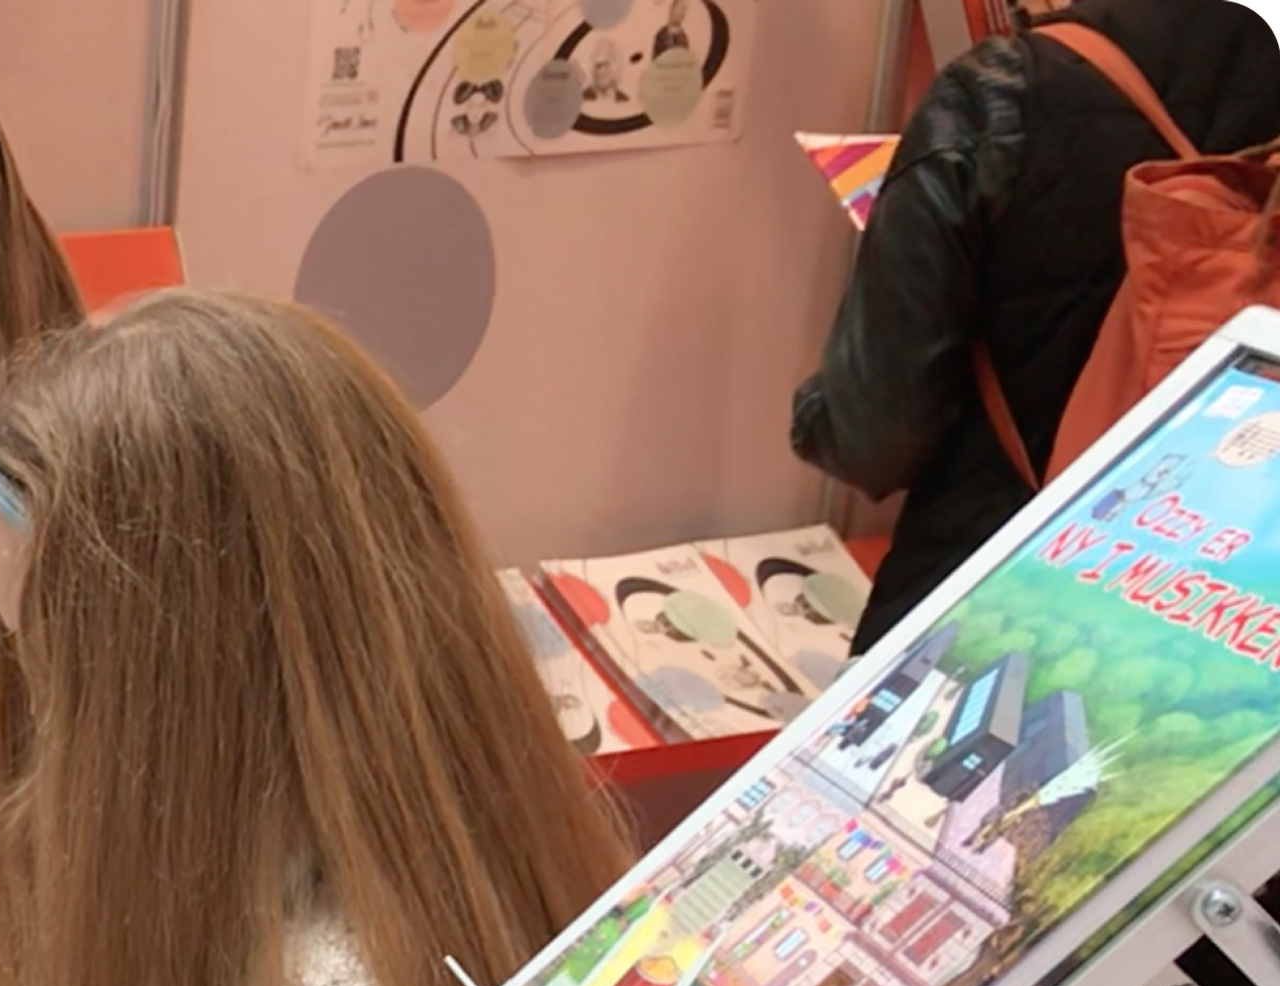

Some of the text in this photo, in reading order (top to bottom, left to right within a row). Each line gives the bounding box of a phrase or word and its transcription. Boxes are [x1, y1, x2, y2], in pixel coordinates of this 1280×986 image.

[1037, 521, 1108, 567] NY
[1077, 541, 1136, 581] I
[1134, 494, 1253, 562] OZZY ER
